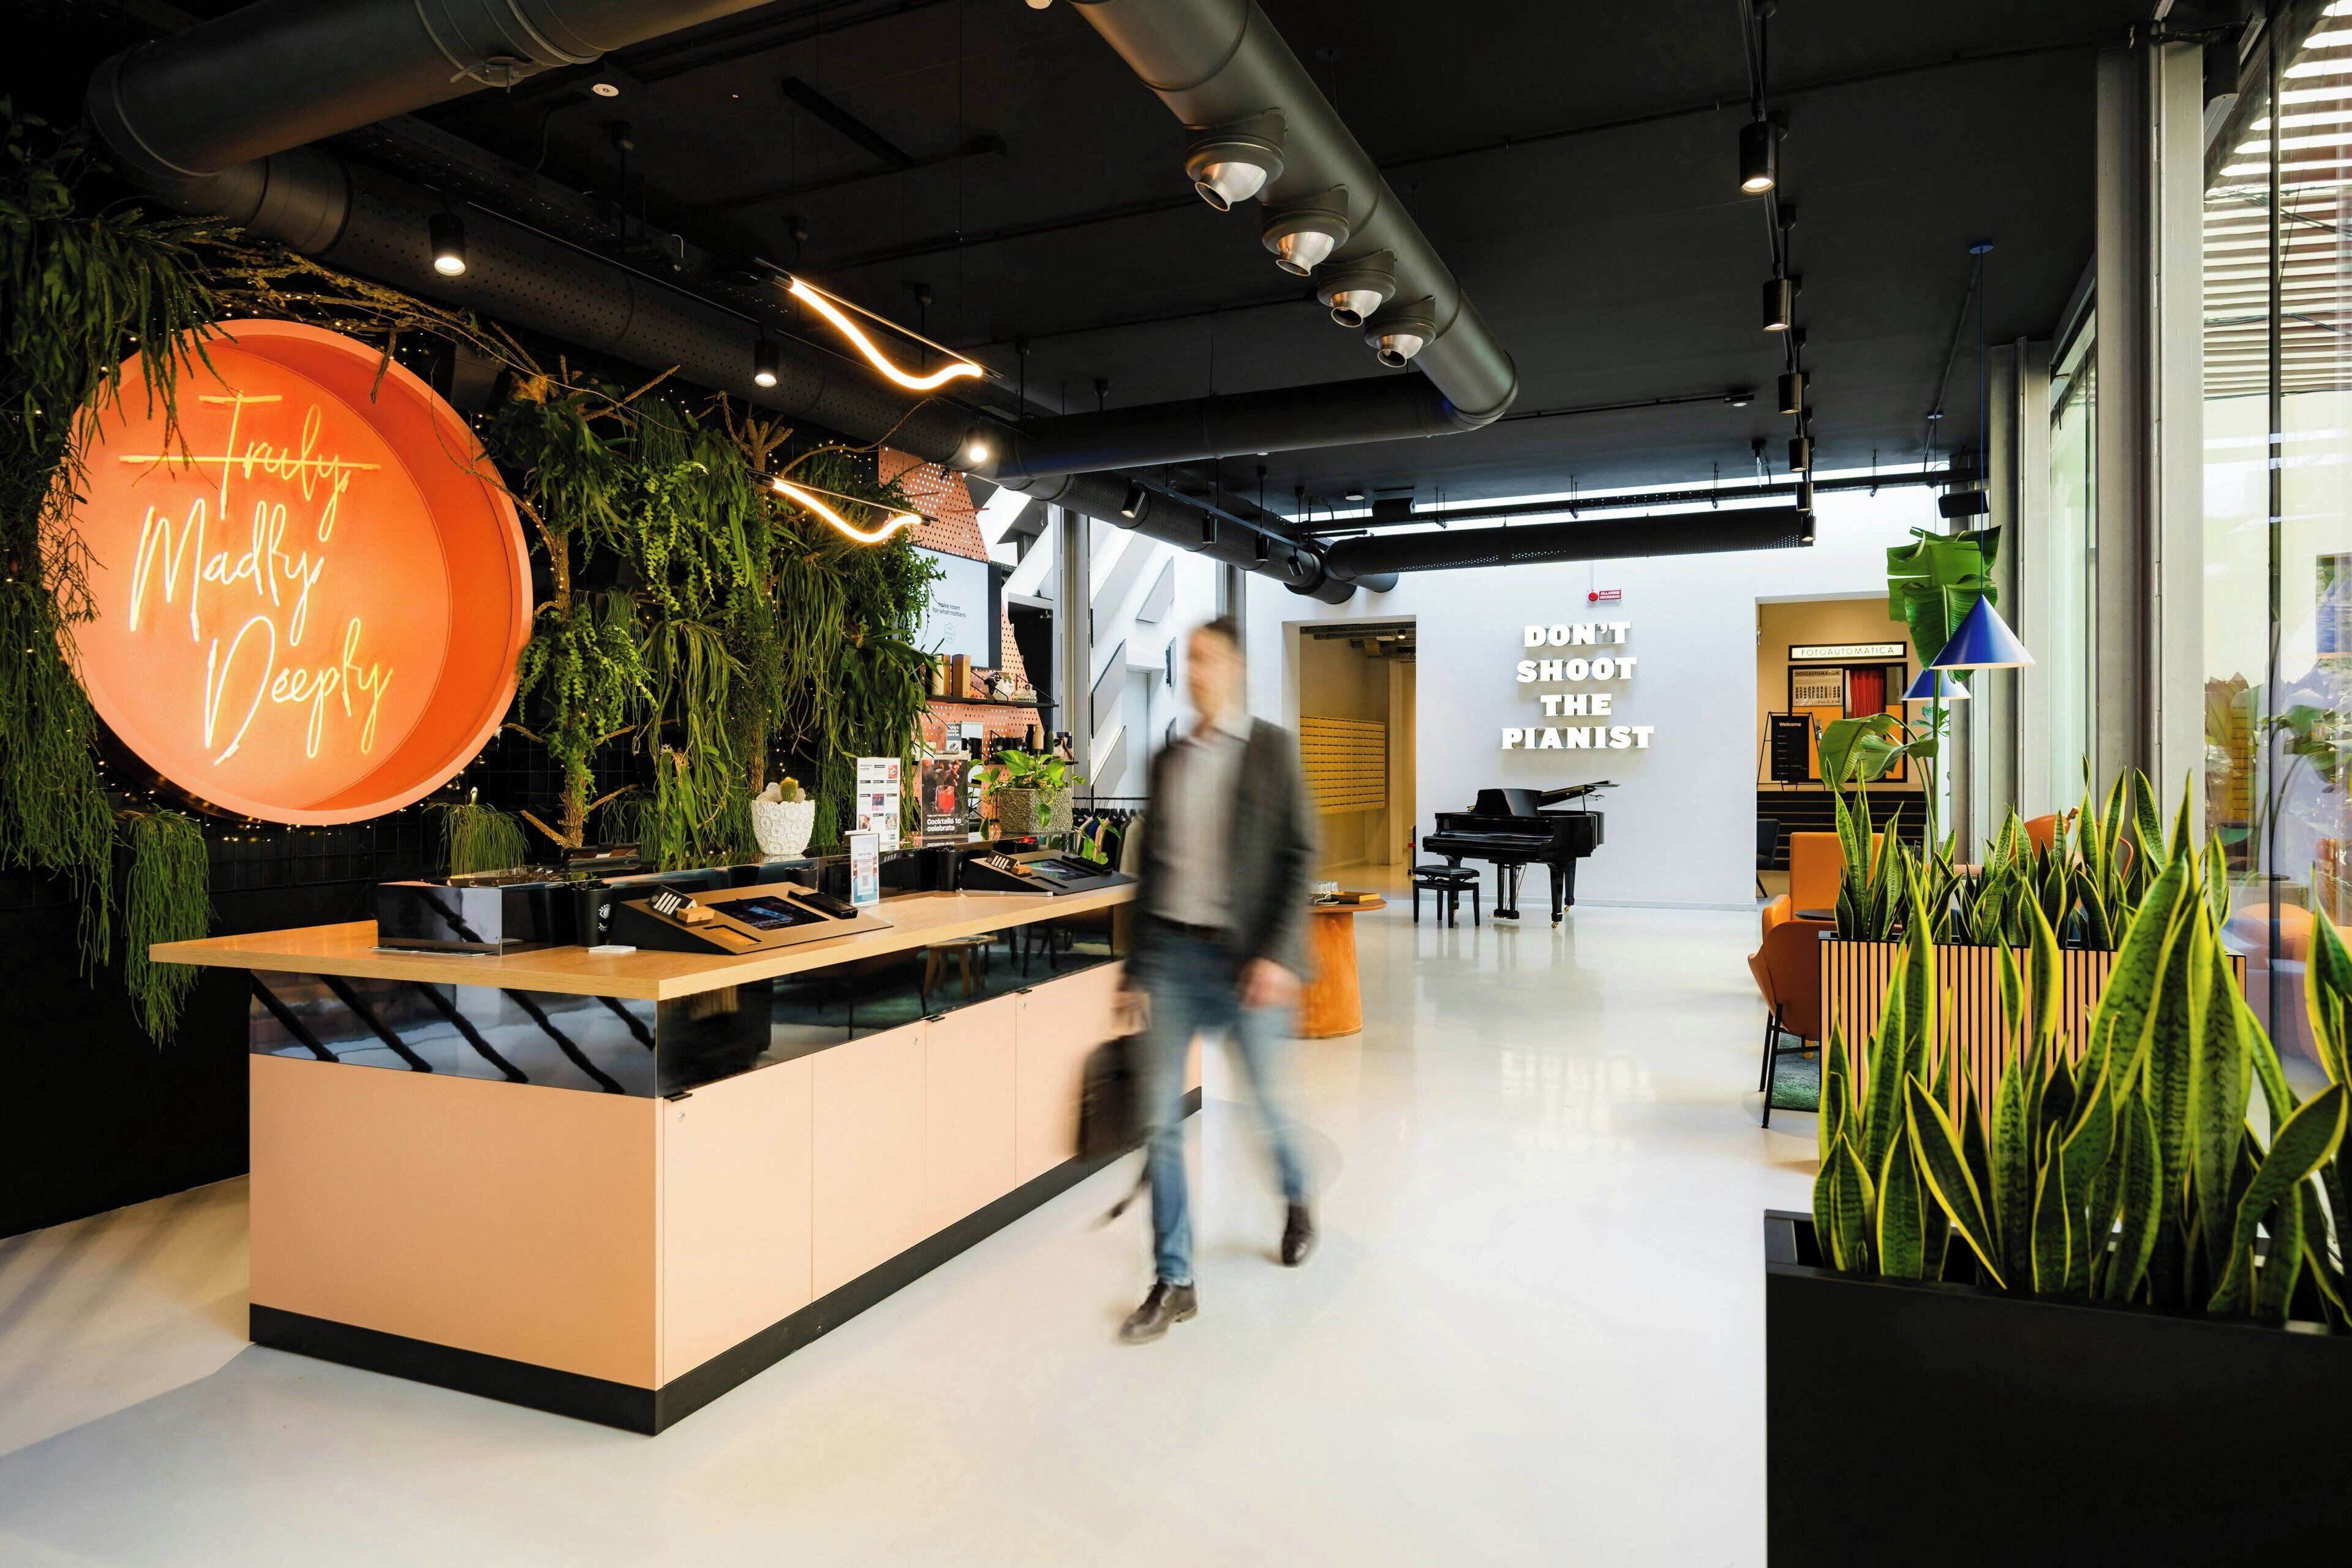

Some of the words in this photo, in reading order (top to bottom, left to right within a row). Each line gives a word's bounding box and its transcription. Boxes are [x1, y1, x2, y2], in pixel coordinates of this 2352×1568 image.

[119, 391, 381, 541] Truly
[130, 499, 324, 646] Madly
[1523, 622, 1631, 647] DON'T
[1801, 647, 1894, 656] FOTOAUTOMATICA
[1516, 657, 1637, 683] SHOOT
[205, 616, 393, 765] Deeply
[1540, 693, 1612, 717] THE
[1501, 726, 1654, 749] PIANIST
